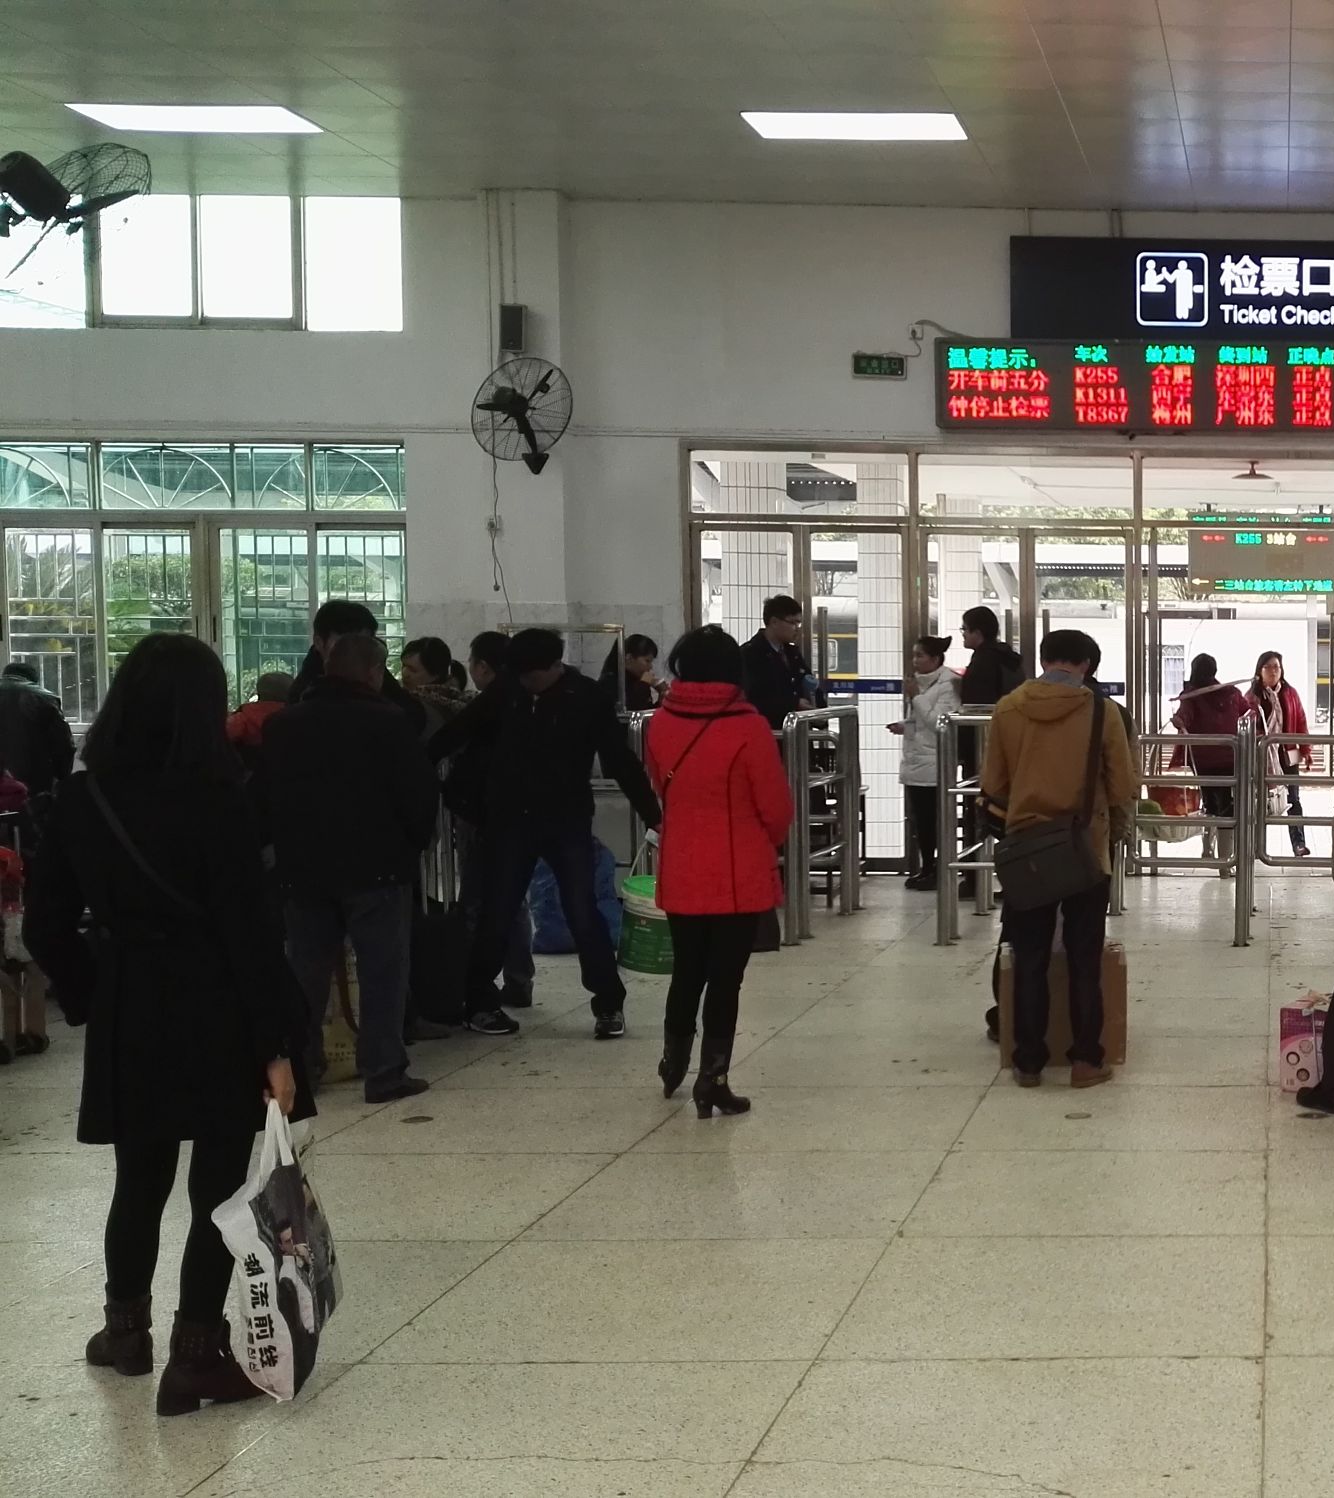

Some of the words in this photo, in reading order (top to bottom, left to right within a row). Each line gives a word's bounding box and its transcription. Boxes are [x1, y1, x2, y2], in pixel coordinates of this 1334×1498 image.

[1220, 304, 1278, 325] Ticket
[1075, 345, 1108, 363] 车次
[948, 369, 1050, 392] 开车前五分
[1075, 367, 1119, 384] K255
[1152, 365, 1192, 386] 合肥
[1293, 366, 1331, 386] 正点
[1075, 387, 1128, 403] K1311
[1293, 386, 1331, 406] 正点
[948, 395, 1050, 419] 钟停止检票
[1075, 406, 1129, 424] T8367
[1293, 406, 1331, 426] 正点
[1235, 532, 1263, 545] K255
[244, 1252, 278, 1368] 潮流前线
